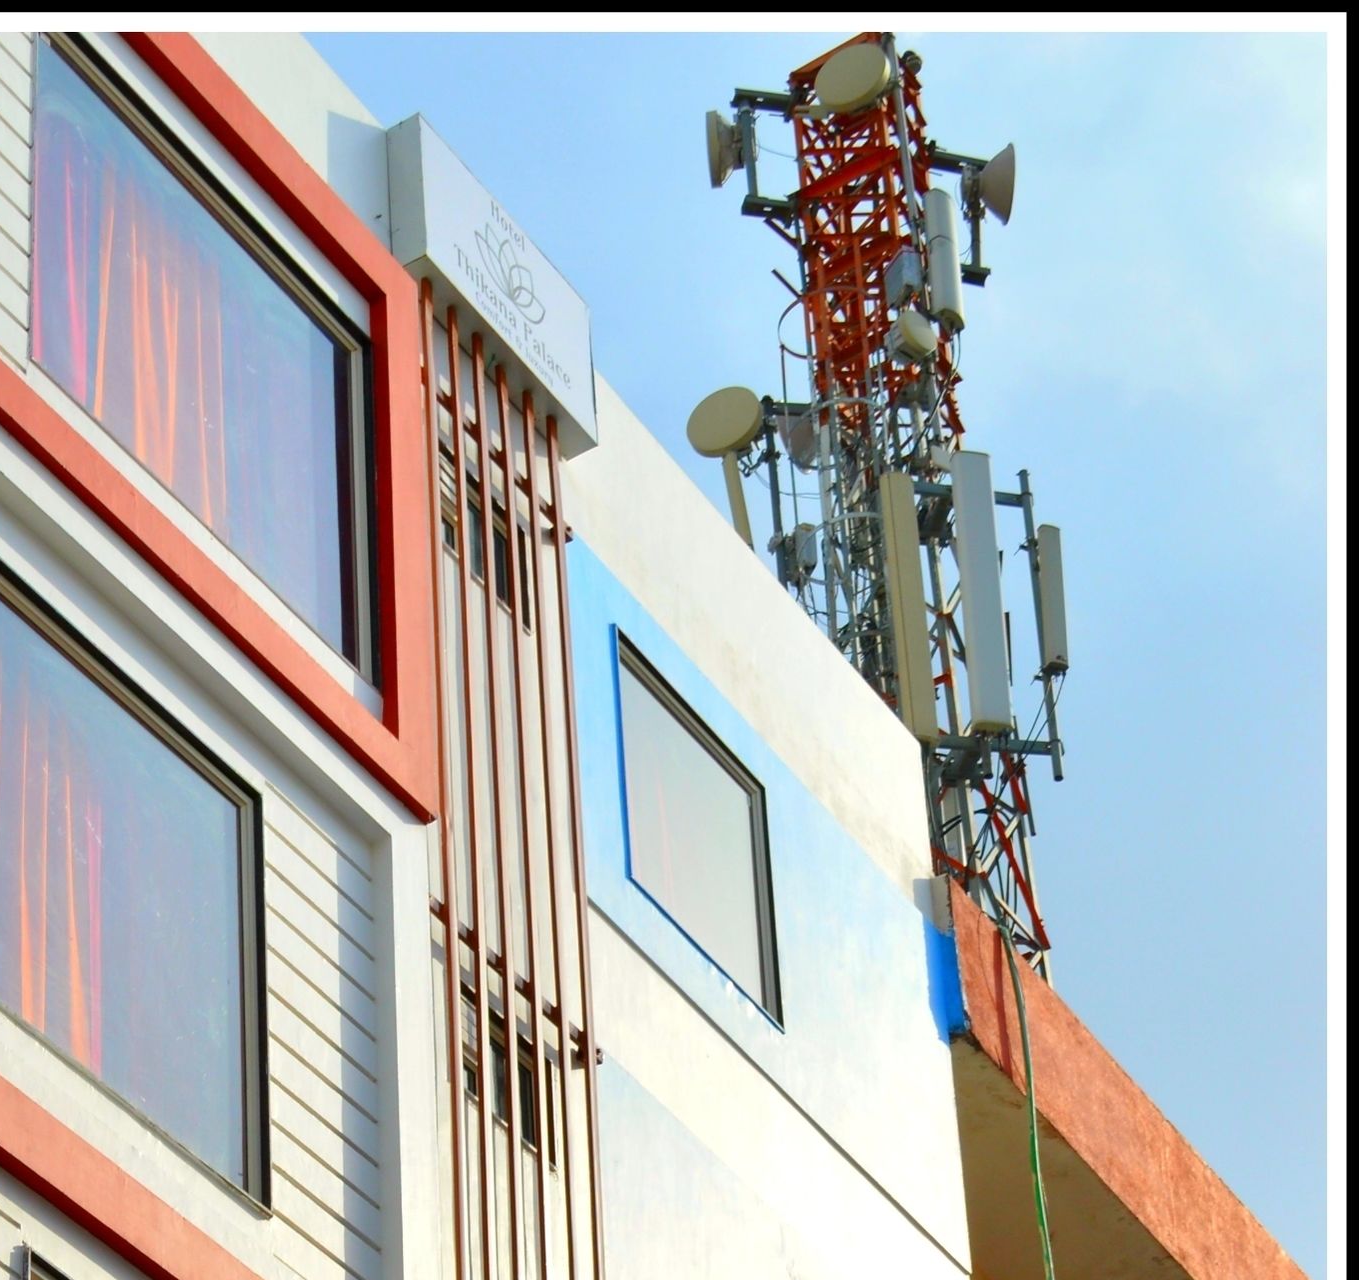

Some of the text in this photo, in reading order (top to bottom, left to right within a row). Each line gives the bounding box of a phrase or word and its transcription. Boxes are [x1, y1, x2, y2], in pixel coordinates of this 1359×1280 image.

[490, 200, 526, 252] Hotel
[453, 243, 572, 390] Thikana Palace
[475, 291, 512, 339] Comfort
